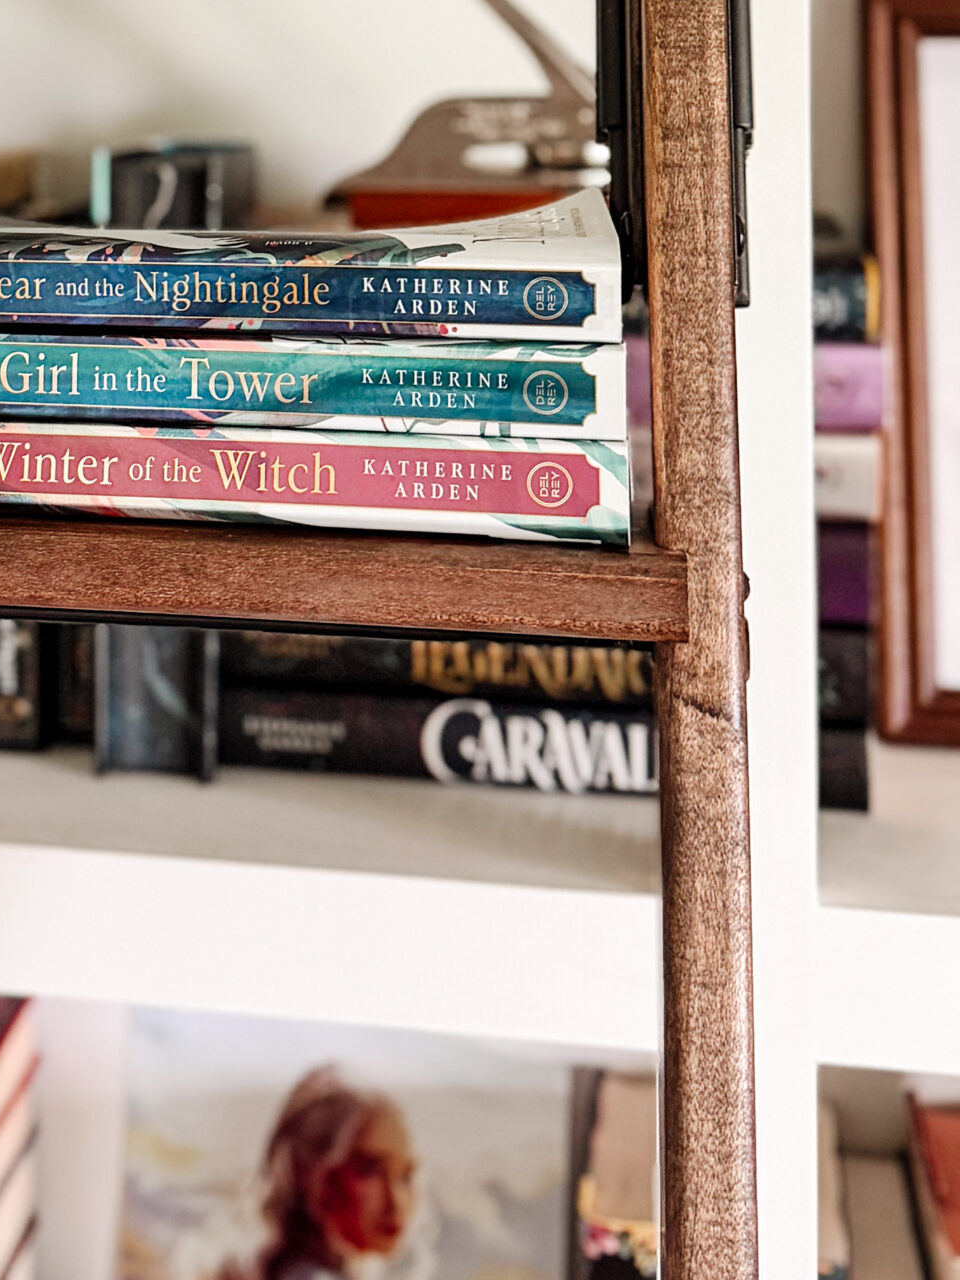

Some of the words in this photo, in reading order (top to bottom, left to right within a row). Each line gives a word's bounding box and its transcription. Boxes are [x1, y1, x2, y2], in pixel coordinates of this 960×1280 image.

[55, 278, 90, 297] and
[95, 280, 125, 297] the
[133, 271, 331, 314] Nightingale
[362, 277, 510, 296] KATHERINE
[535, 285, 545, 311] DEL
[547, 285, 556, 311] REY
[393, 299, 477, 316] ARDEN
[0, 351, 81, 396] Girl
[93, 366, 118, 391] in
[126, 367, 167, 393] the
[179, 356, 319, 404] Tower
[361, 368, 509, 389] KATHERINE
[392, 391, 476, 409] ARDEN
[535, 380, 545, 405] DEL
[547, 379, 556, 406] REY
[128, 456, 156, 482] of
[163, 458, 202, 483] the
[209, 449, 339, 494] Witch
[362, 458, 513, 481] KATHERINE
[394, 482, 480, 501] ARDEN
[540, 471, 549, 498] DEL
[551, 471, 560, 498] REY
[420, 697, 660, 794] CARAVAL
